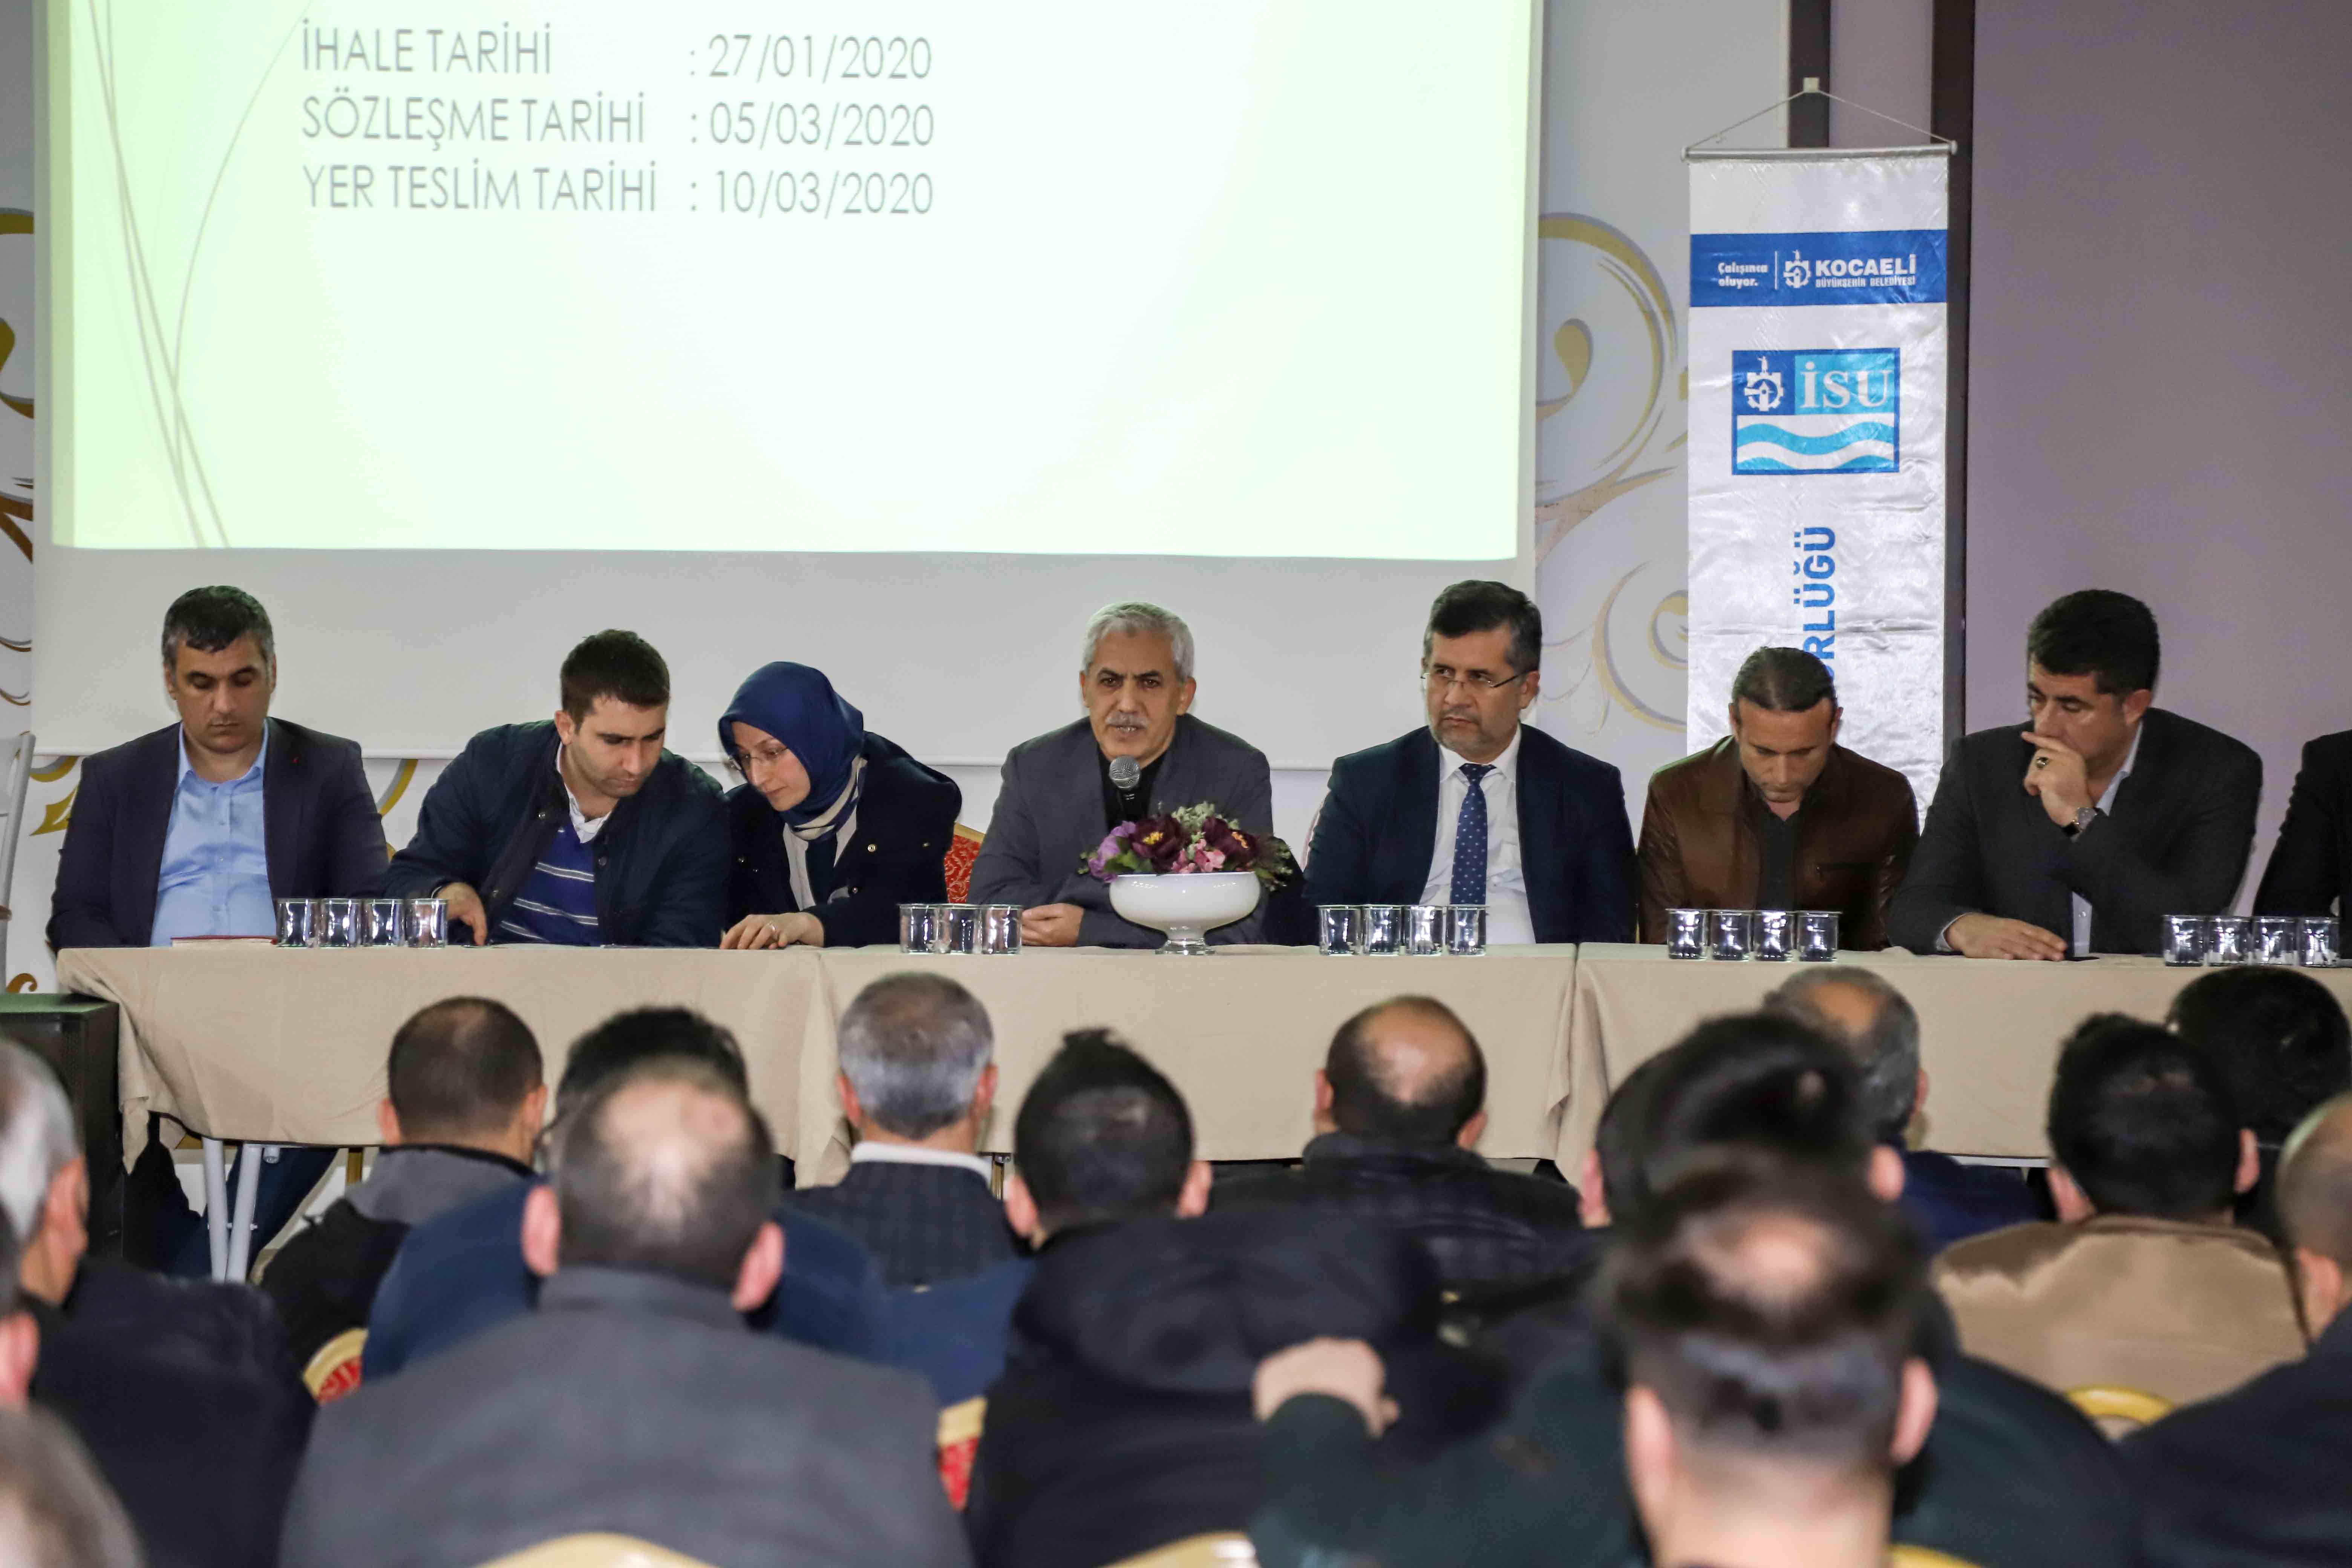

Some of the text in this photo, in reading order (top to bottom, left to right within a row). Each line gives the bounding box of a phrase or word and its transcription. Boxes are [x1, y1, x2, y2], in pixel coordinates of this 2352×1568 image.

[302, 17, 413, 73] İHALE
[426, 20, 550, 74] TARİHİ
[708, 33, 932, 84] 27/01/2020
[302, 86, 509, 152] SÖZLEŞME
[520, 90, 645, 143] TARİHİ
[710, 101, 934, 151] 05/03/2020
[303, 164, 375, 208] YER
[387, 157, 520, 210] TESLİM
[533, 159, 656, 212] TARİHİ
[716, 170, 933, 219] 10/03/2020
[1718, 262, 1769, 275] Çalışınca
[1718, 276, 1758, 289] oluyor.
[1815, 254, 1916, 277] KOCAELİ
[1799, 361, 1893, 408] İSU
[1793, 527, 1836, 681] RLÜĞÜ
